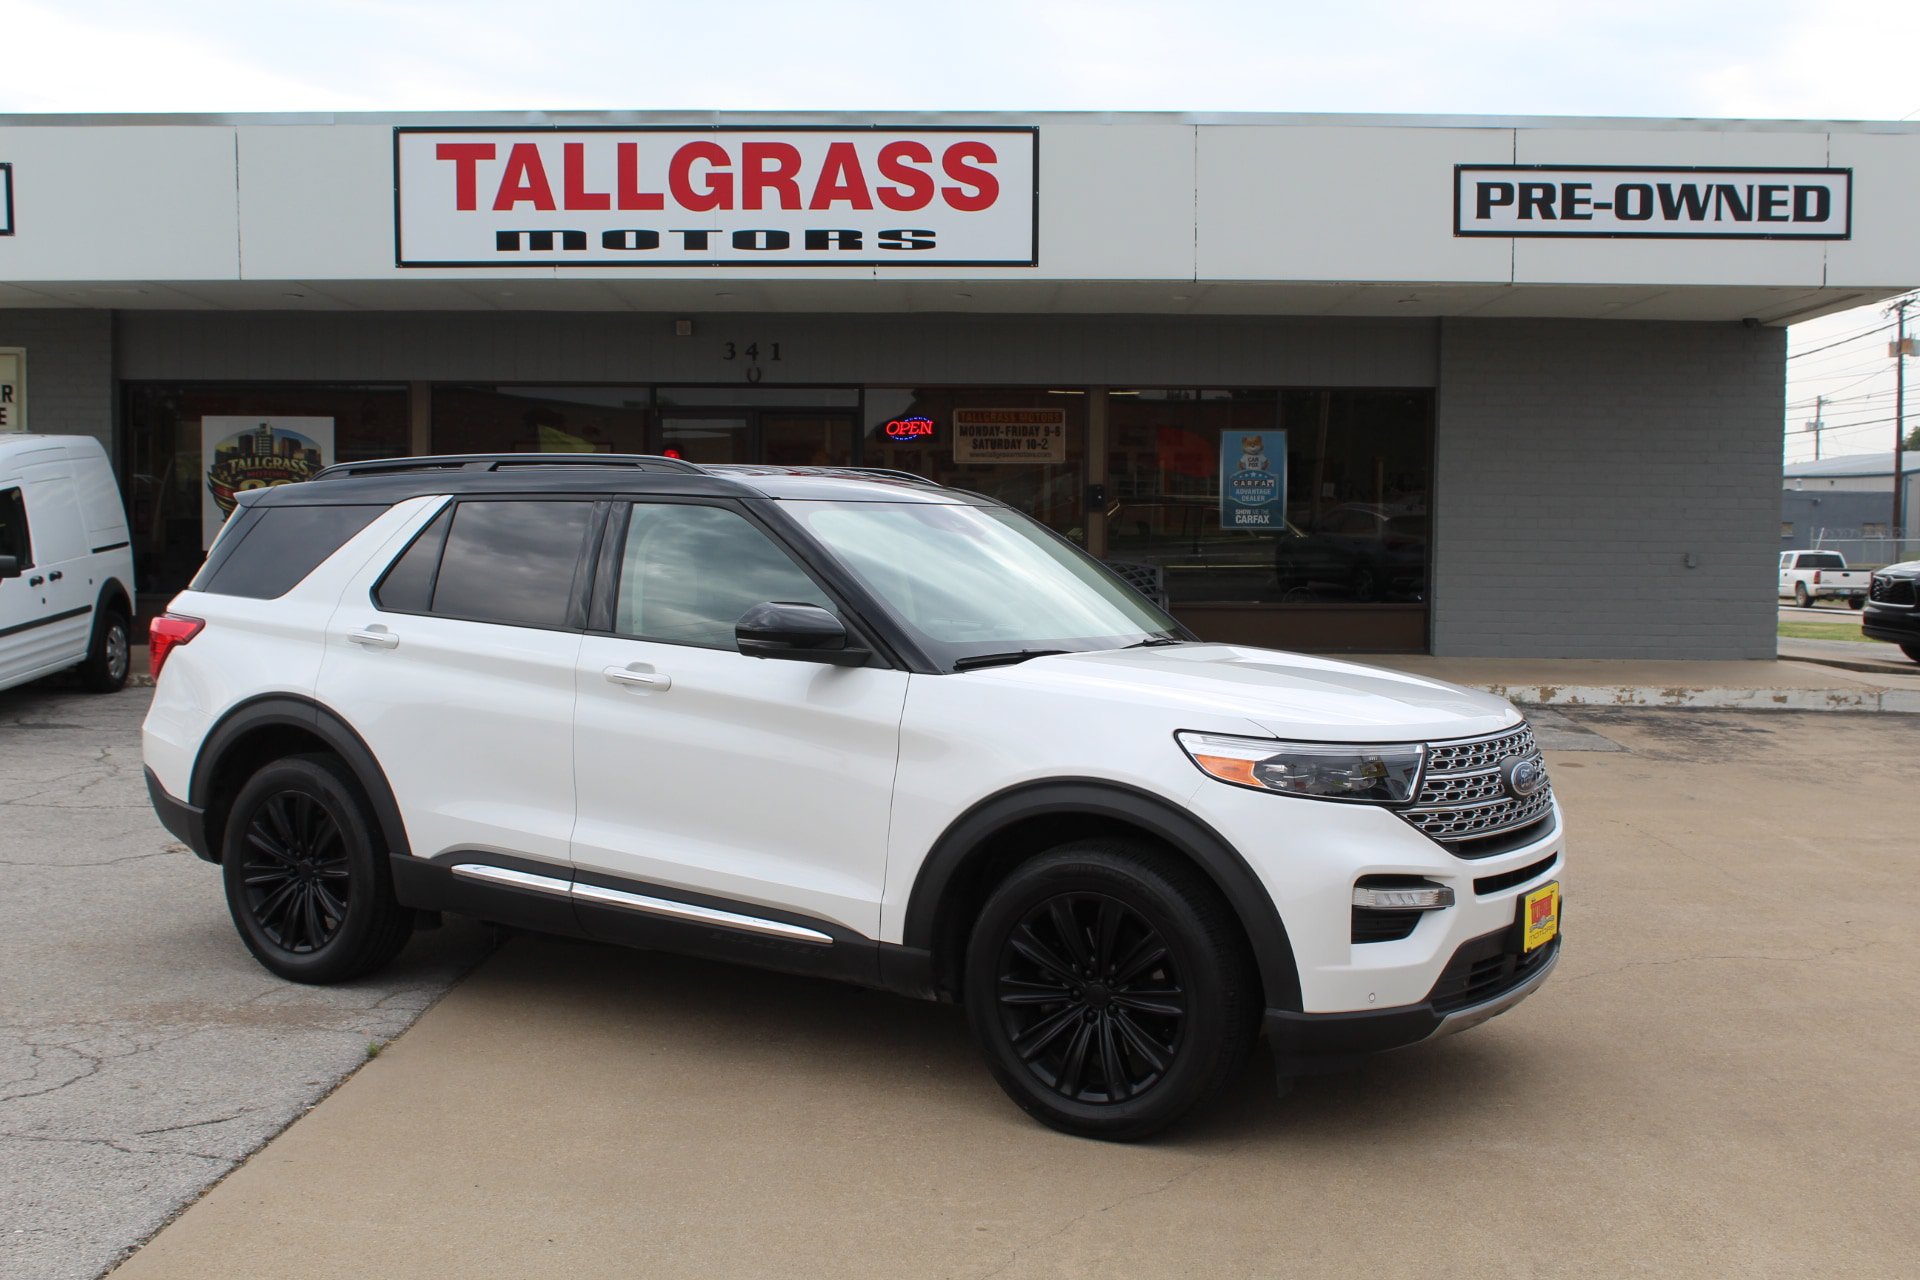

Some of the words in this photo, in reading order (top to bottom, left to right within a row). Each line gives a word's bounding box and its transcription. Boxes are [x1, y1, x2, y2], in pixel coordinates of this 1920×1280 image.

[436, 142, 998, 211] TALLGRASS
[1475, 182, 1831, 223] PRE-OWNED
[722, 341, 782, 361] 341
[960, 412, 1015, 421] TALLGRASS
[1019, 412, 1061, 421] MOTORS
[886, 420, 934, 435] OPEN
[959, 425, 1040, 437] MONDAY-FRIDAY
[972, 438, 1022, 450] SATURDAY
[1026, 439, 1049, 450] 10-2
[227, 456, 309, 476] TALLGRASS
[1235, 515, 1270, 524] CARFAX
